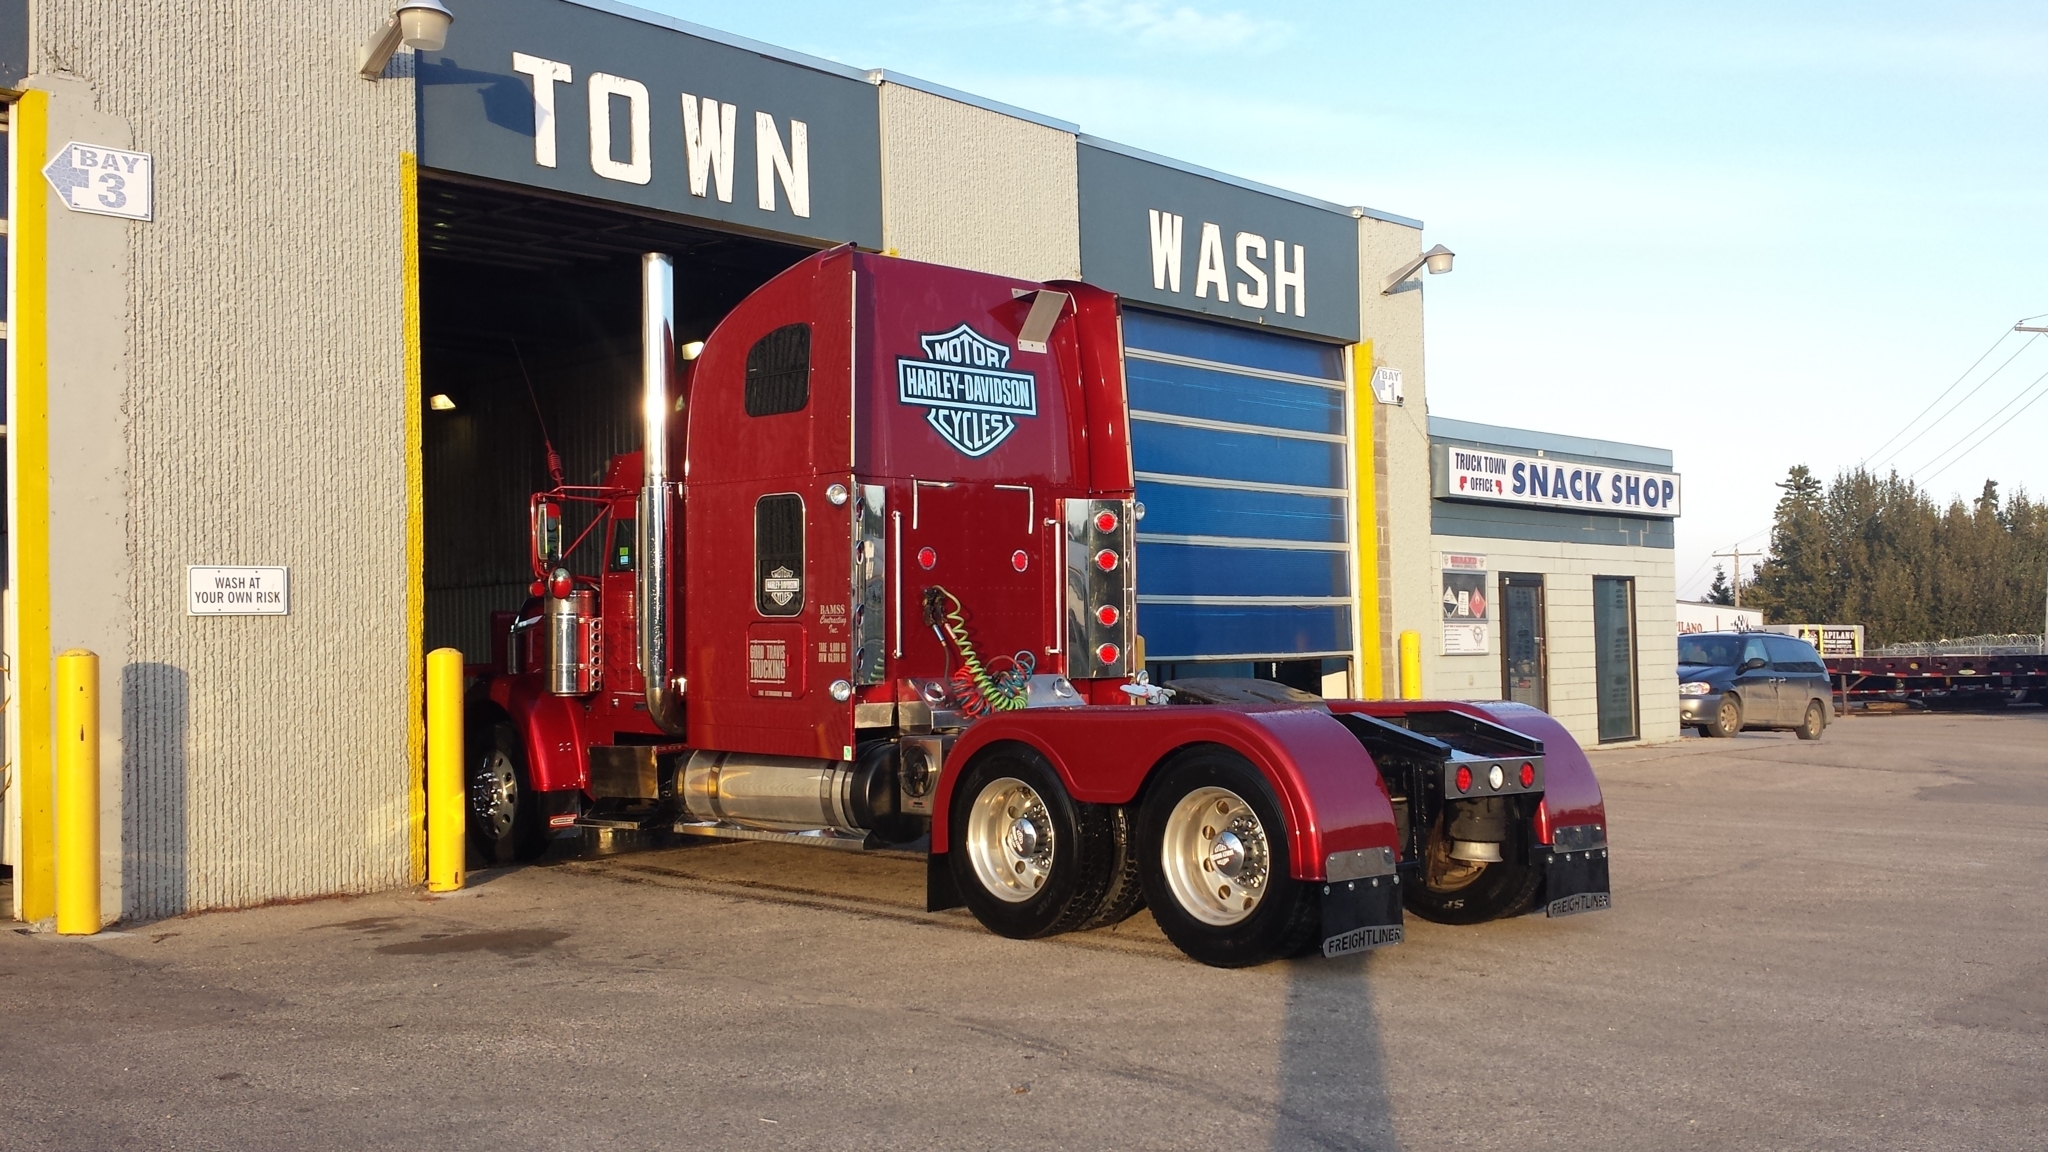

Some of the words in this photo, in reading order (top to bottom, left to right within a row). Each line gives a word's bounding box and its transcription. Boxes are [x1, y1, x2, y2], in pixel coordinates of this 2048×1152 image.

[512, 51, 810, 218] TOWN
[80, 149, 140, 174] BAY
[98, 173, 127, 209] 3
[1149, 209, 1305, 318] WASH
[934, 333, 1000, 368] MOTOR
[1382, 370, 1399, 381] BAY
[906, 367, 1030, 407] HARLEY-DAVIDSON
[1388, 382, 1395, 401] 1
[938, 408, 1004, 450] CYCLES
[1455, 452, 1482, 473] TRUCK
[1484, 456, 1507, 476] TOWN
[1470, 477, 1493, 493] OFFICE
[1511, 461, 1603, 503] SNACK
[1611, 474, 1674, 509] SHOP
[215, 577, 245, 589] WASH
[249, 577, 261, 589] AT
[195, 591, 224, 604] YOUR
[228, 591, 253, 604] OWN
[256, 591, 281, 604] RISK
[820, 604, 845, 615] BAMSS
[1676, 621, 1703, 633] ILANO
[1822, 631, 1855, 640] APILANO
[750, 659, 786, 679] TRUCKING
[1552, 895, 1608, 914] FREIGHTLINER
[1328, 928, 1401, 953] FREIGHTLINER
